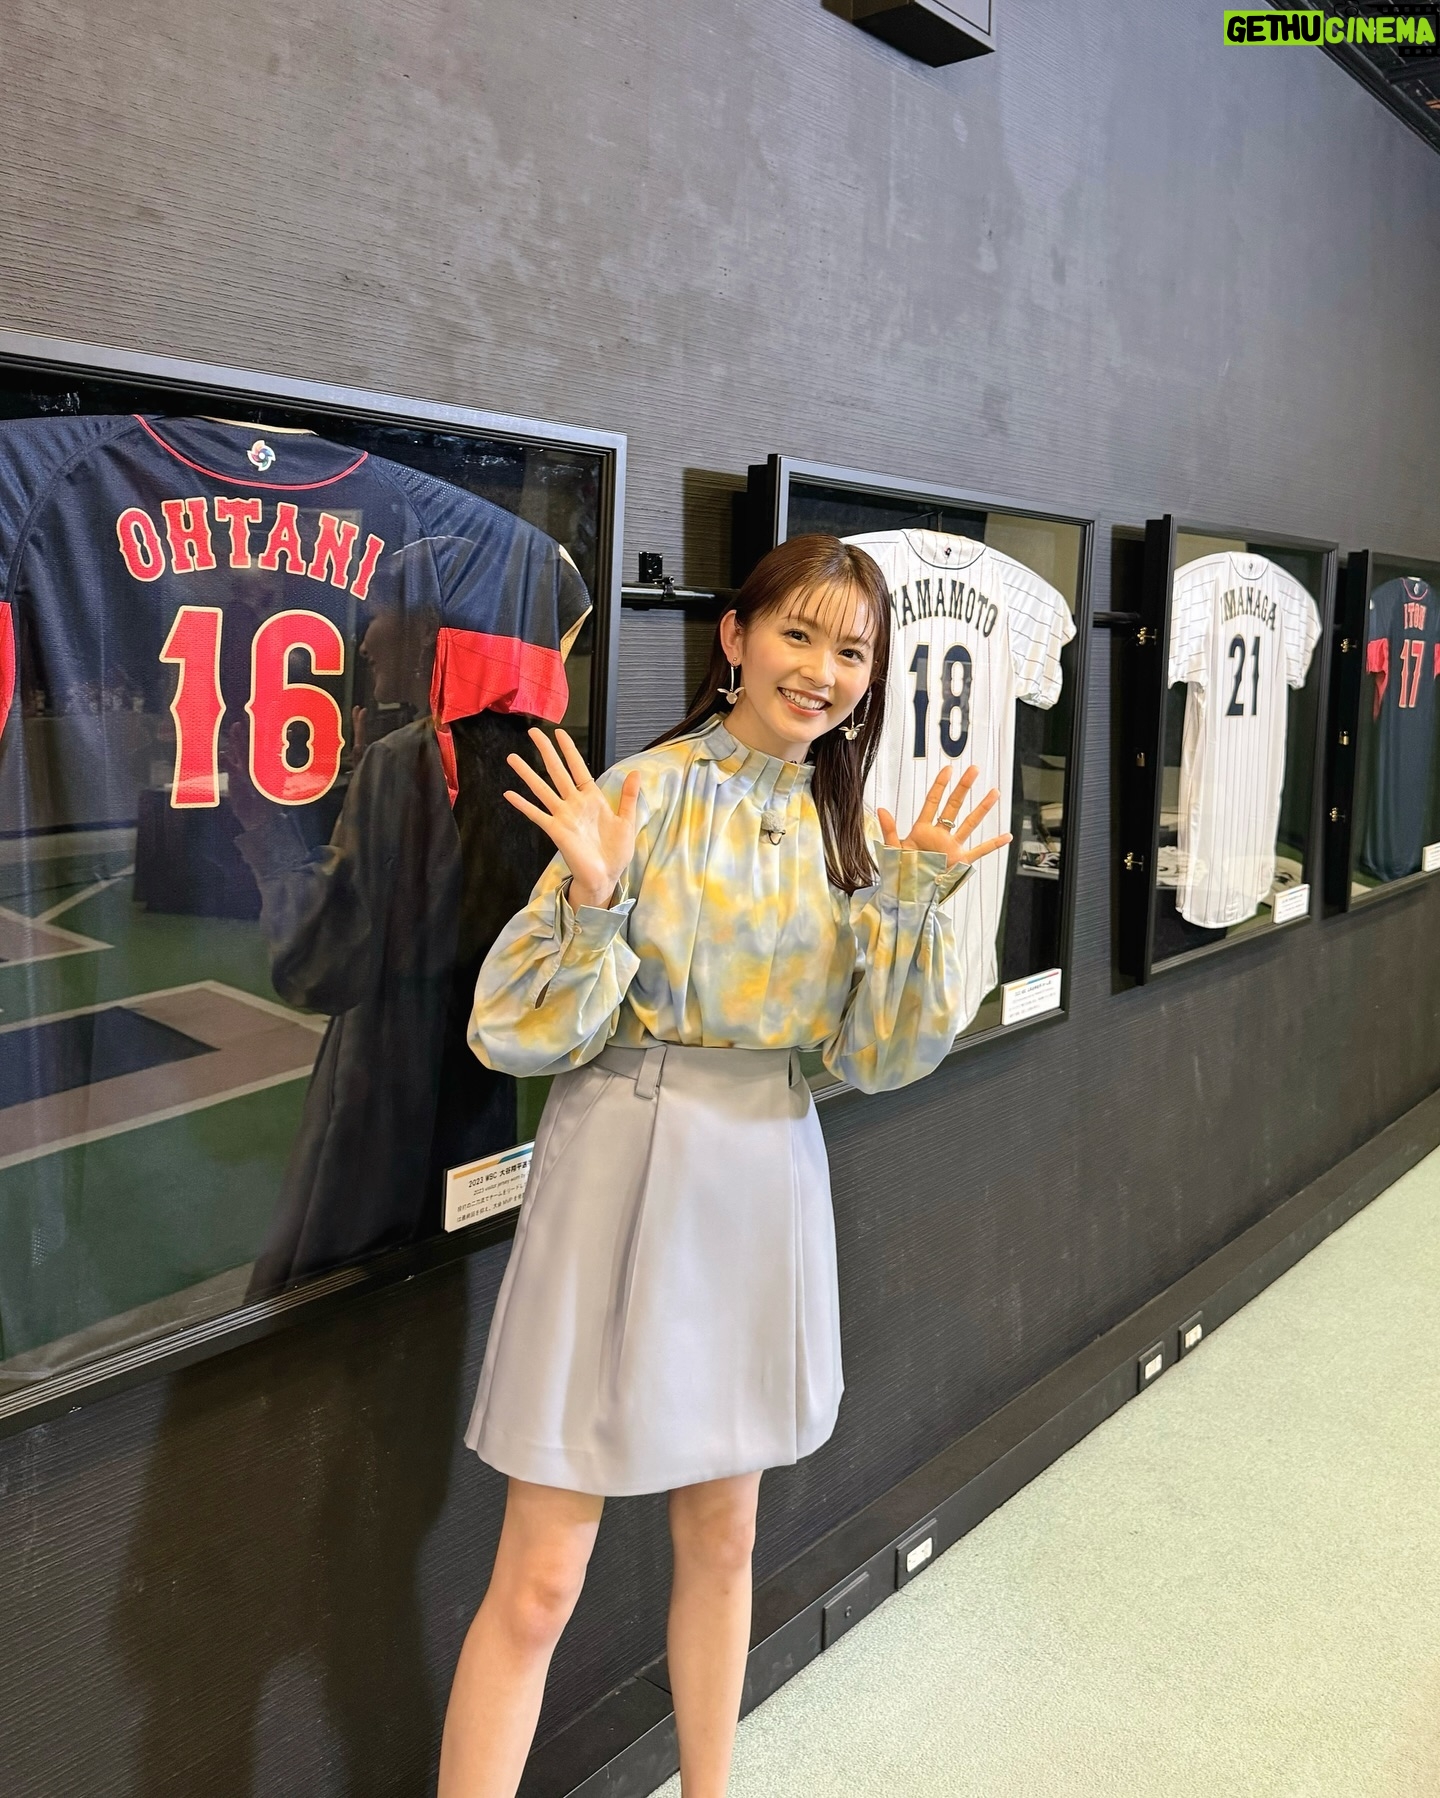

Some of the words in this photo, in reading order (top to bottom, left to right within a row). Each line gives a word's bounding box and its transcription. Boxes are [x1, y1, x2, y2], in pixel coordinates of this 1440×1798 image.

[116, 497, 385, 600] OHTANI
[889, 578, 999, 638] YAMAMOTO
[1220, 586, 1278, 631] IMANAGA
[159, 606, 345, 809] 16
[908, 642, 974, 760] 18
[1225, 634, 1262, 717] 21
[1398, 638, 1426, 709] 17
[468, 1176, 484, 1188] 2023
